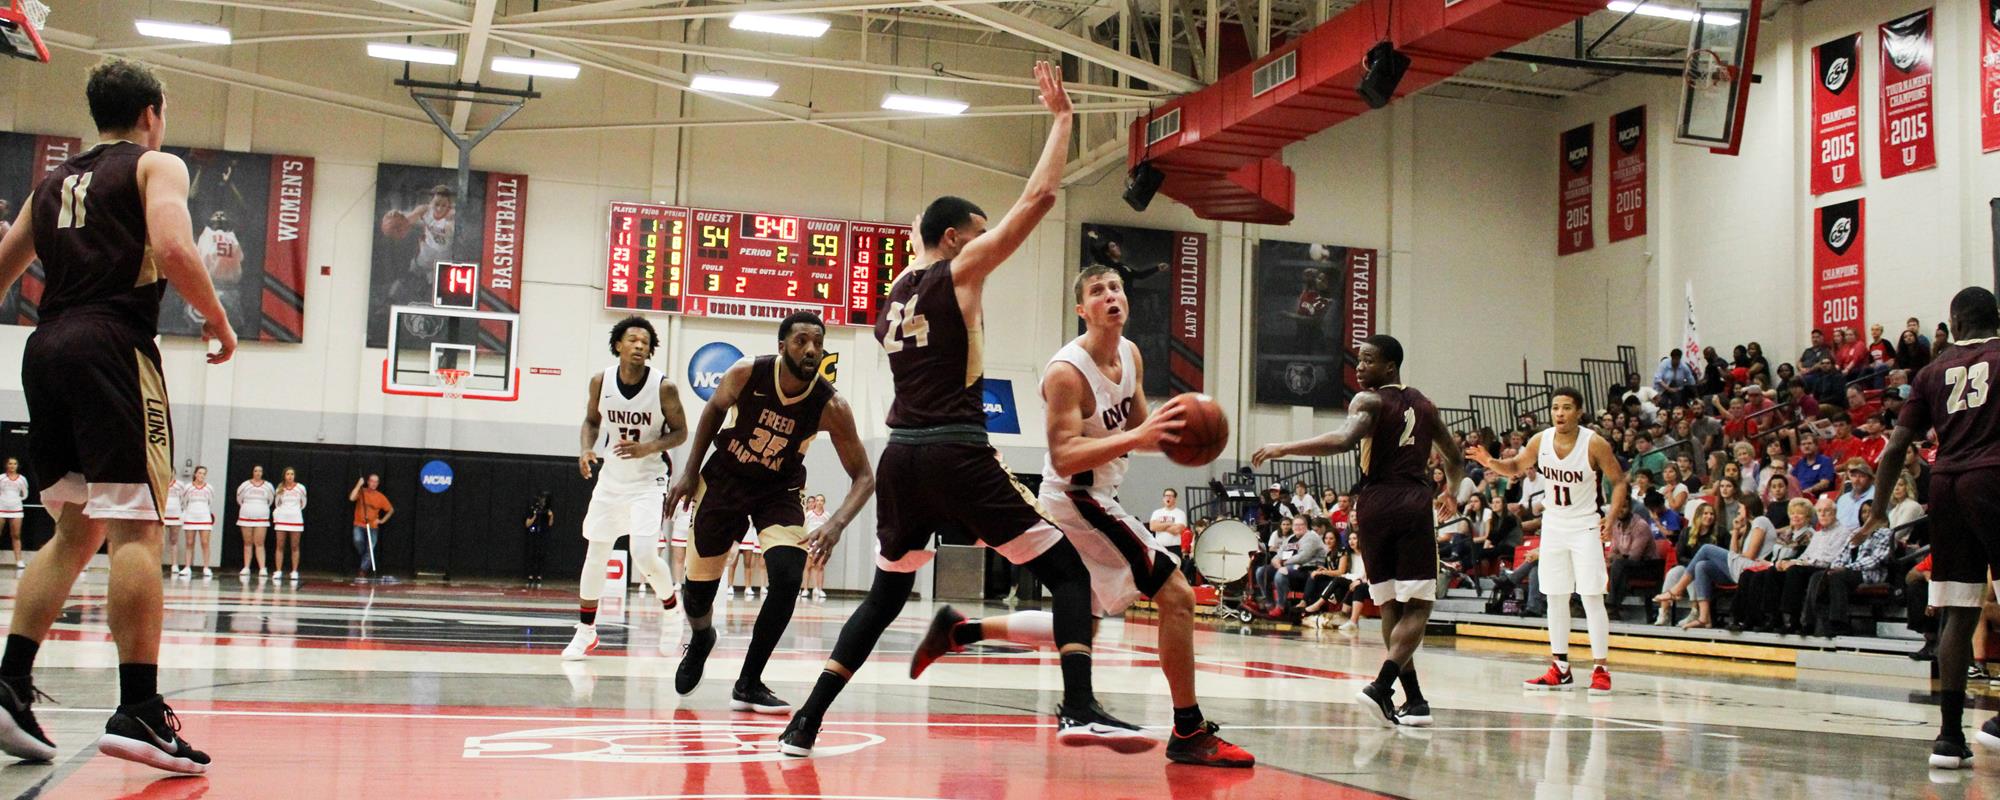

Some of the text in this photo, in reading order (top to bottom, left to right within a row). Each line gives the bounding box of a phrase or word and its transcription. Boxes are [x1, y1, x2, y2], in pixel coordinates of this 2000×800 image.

[1886, 73, 1932, 97] TOURNAMENT
[1889, 87, 1927, 108] CHAMPIONS
[1821, 106, 1857, 125] CHAMPIONS
[1618, 126, 1640, 142] NCAA
[1891, 113, 1927, 145] 2015
[1568, 146, 1588, 161] NCAA
[1822, 133, 1855, 164] 2015
[57, 171, 93, 229] 11
[278, 160, 304, 242] WOMEN'S
[1616, 188, 1642, 213] 2016
[613, 206, 637, 214] PLAYER
[696, 212, 733, 223] GUEST
[1566, 205, 1589, 230] 2015
[491, 178, 518, 290] BASKETBALL
[623, 217, 632, 230] 2
[673, 220, 683, 234] 2
[755, 216, 796, 240] 9:40
[807, 221, 841, 232] UNION
[852, 225, 874, 233] PLAYER
[619, 232, 631, 245] 11
[647, 234, 657, 248] 0
[703, 225, 730, 248] 54
[812, 234, 838, 256] 59
[858, 236, 871, 249] 11
[885, 238, 894, 251] 2
[613, 247, 630, 261] 23
[646, 250, 656, 263] 2
[740, 246, 788, 263] PERIOD 2
[885, 253, 894, 265] 0
[612, 263, 629, 277] 24
[645, 265, 655, 279] 2
[702, 264, 724, 272] FOULS
[741, 267, 757, 275] TIME
[759, 268, 776, 276] OUTS
[853, 265, 869, 279] 20
[1822, 264, 1858, 280] CHAMPIONS
[449, 267, 472, 294] 14
[644, 280, 654, 294] 2
[708, 274, 720, 291] 3
[735, 276, 747, 293] 2
[787, 280, 798, 297] 2
[852, 281, 868, 294] 23
[1181, 236, 1198, 338] LADY BULLDOG
[817, 283, 829, 299] 4
[710, 302, 746, 316] UNION
[852, 296, 867, 309] 33
[1352, 253, 1369, 349] VOLLEYBALL
[1823, 296, 1858, 324] 2016
[1945, 361, 1989, 414] 23
[146, 398, 167, 446] LIONS
[607, 410, 651, 426] UNION
[758, 408, 795, 435] FREED
[1399, 406, 1416, 447] 2
[749, 427, 788, 457] 35
[423, 475, 452, 486] NCAA
[1543, 466, 1583, 483] UNION
[1554, 485, 1572, 506] 11
